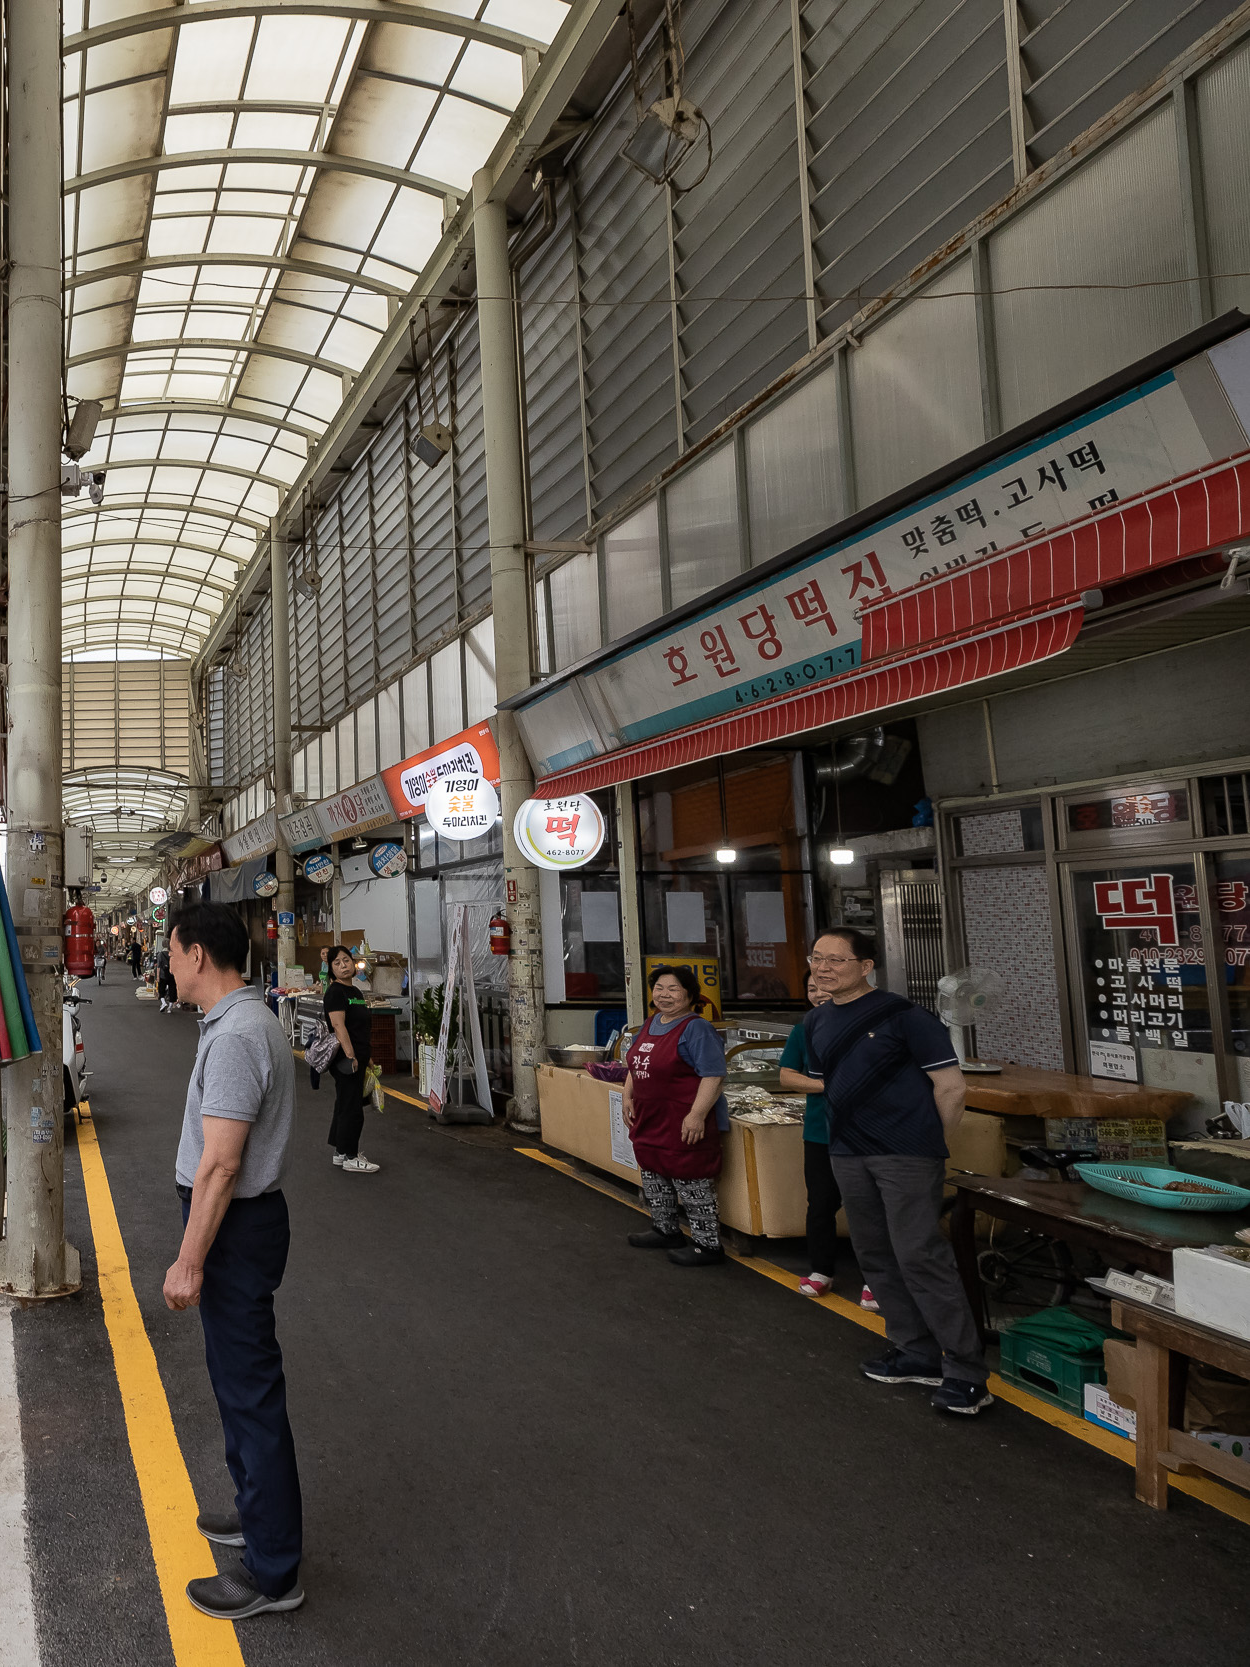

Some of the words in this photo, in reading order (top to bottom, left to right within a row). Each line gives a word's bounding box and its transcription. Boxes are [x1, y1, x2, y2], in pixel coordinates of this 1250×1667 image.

[444, 778, 480, 793] 기영이
[448, 794, 475, 813] 숯불
[543, 800, 582, 812] 호원당
[442, 814, 488, 828] 두마리치킨
[544, 813, 581, 848] 떡
[1093, 873, 1180, 947] 떡
[1108, 958, 1181, 974] 마춤전문
[1112, 992, 1185, 1011] 고사머리
[1112, 1009, 1184, 1029] 머리고기
